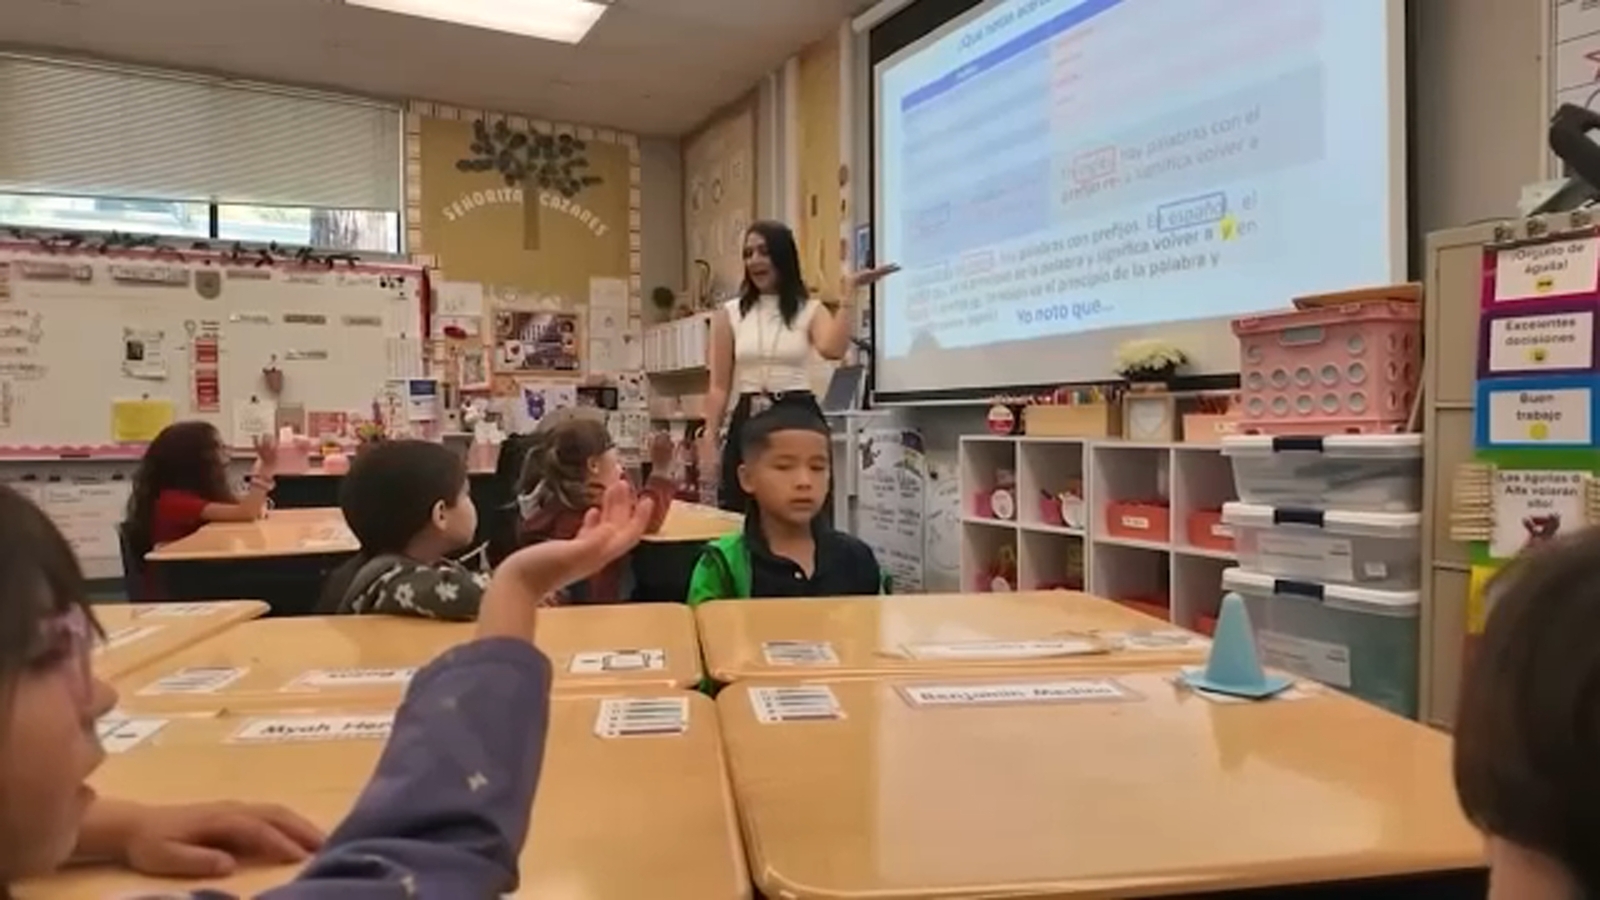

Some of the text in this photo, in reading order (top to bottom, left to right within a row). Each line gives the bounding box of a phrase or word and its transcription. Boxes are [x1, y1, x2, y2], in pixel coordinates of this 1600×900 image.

[1146, 126, 1208, 157] palabras
[1210, 115, 1242, 136] con
[1245, 102, 1261, 126] el
[1195, 136, 1245, 165] volver
[1241, 187, 1259, 211] el
[1152, 229, 1199, 251] volver
[1567, 243, 1585, 253] de
[1112, 265, 1130, 281] de
[1131, 262, 1147, 277] la
[1148, 252, 1207, 279] palabra
[1034, 302, 1069, 322] noto
[1504, 318, 1577, 332] Excelentes
[1504, 333, 1576, 347] decisiones
[1518, 391, 1555, 404] Buen
[1515, 409, 1562, 422] trabajo
[259, 722, 331, 736] Myah
